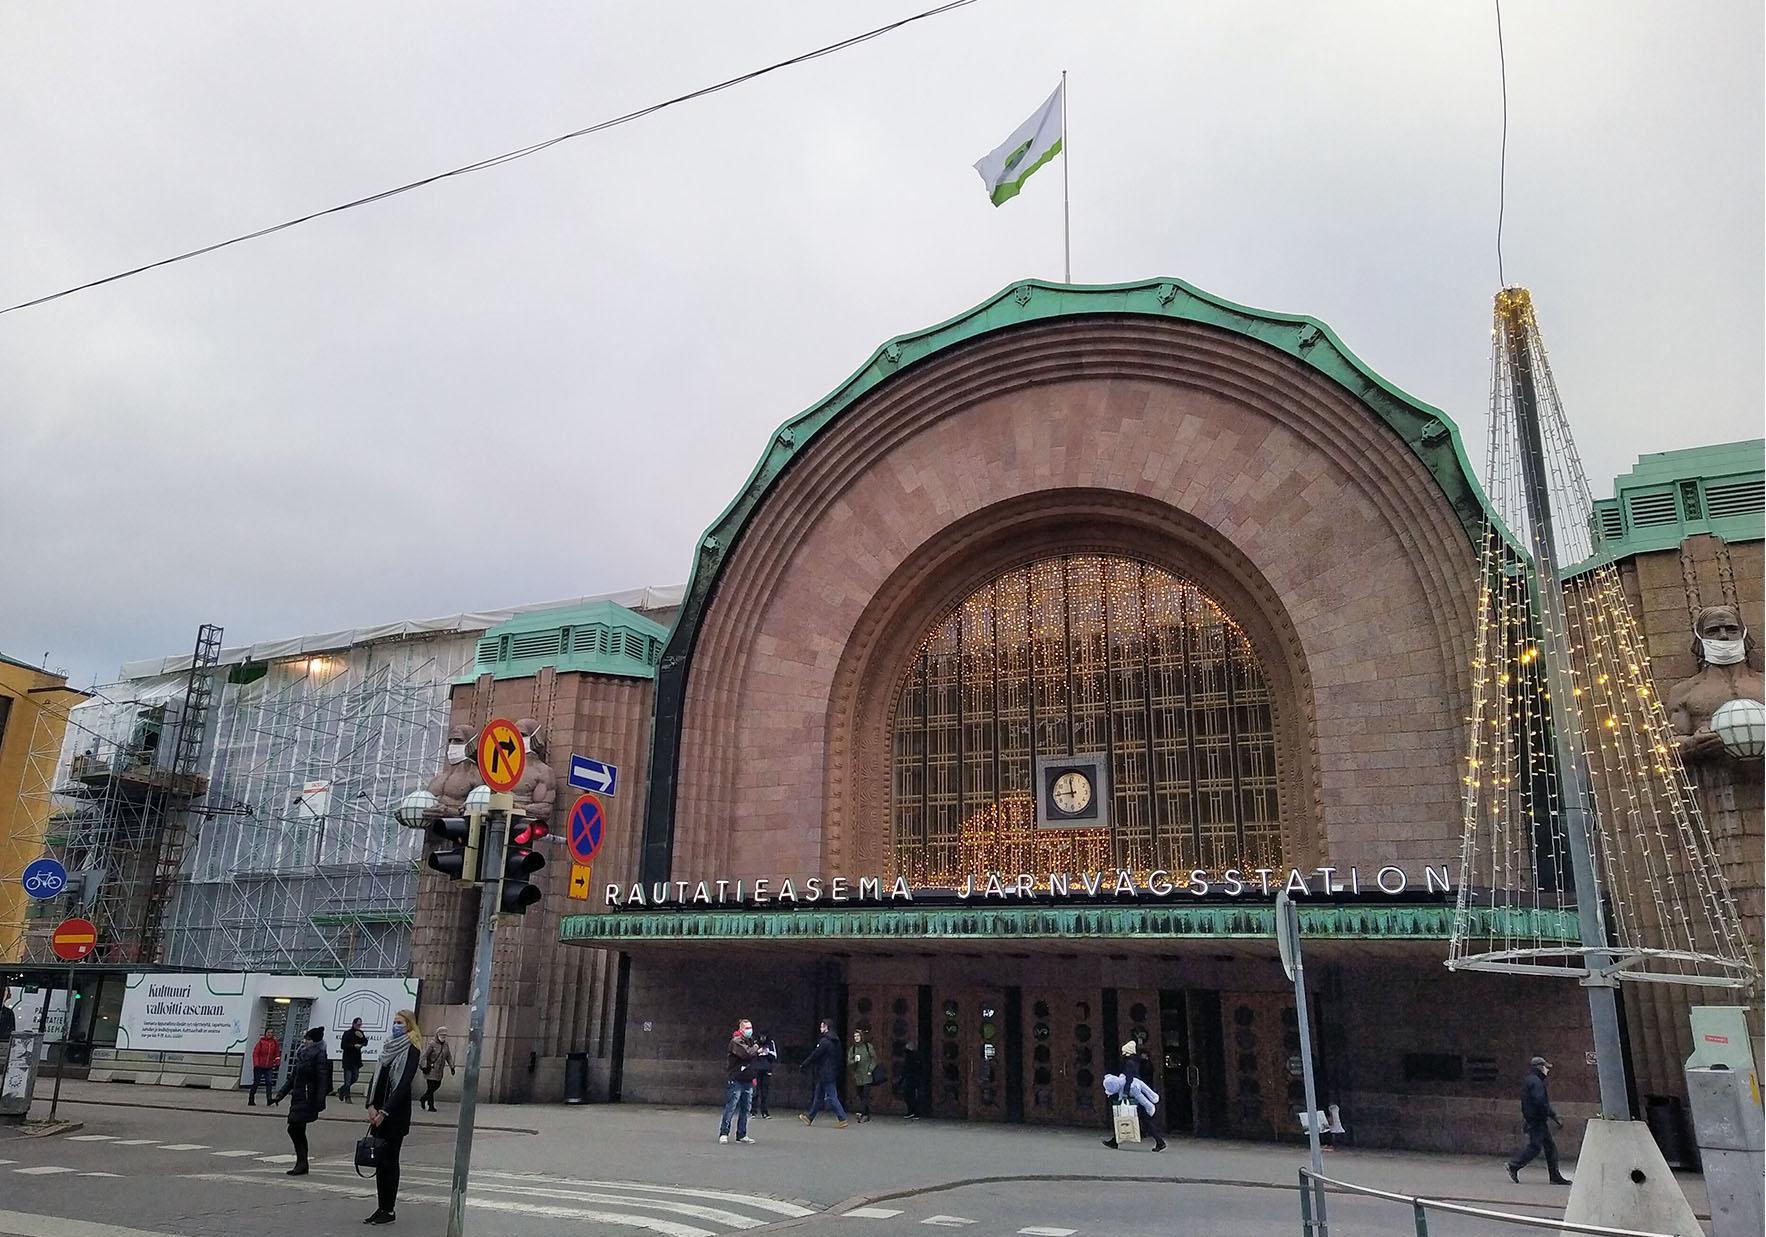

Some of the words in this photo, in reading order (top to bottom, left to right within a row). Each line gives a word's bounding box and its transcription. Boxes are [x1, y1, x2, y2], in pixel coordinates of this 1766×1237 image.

[605, 876, 912, 905] RAUTATIEASEMA
[957, 865, 1450, 900] JÄRNVÄGSSTATION
[148, 983, 192, 998] Kulttuuri
[146, 1001, 182, 1015] valloitti
[183, 1003, 225, 1016] aseman.
